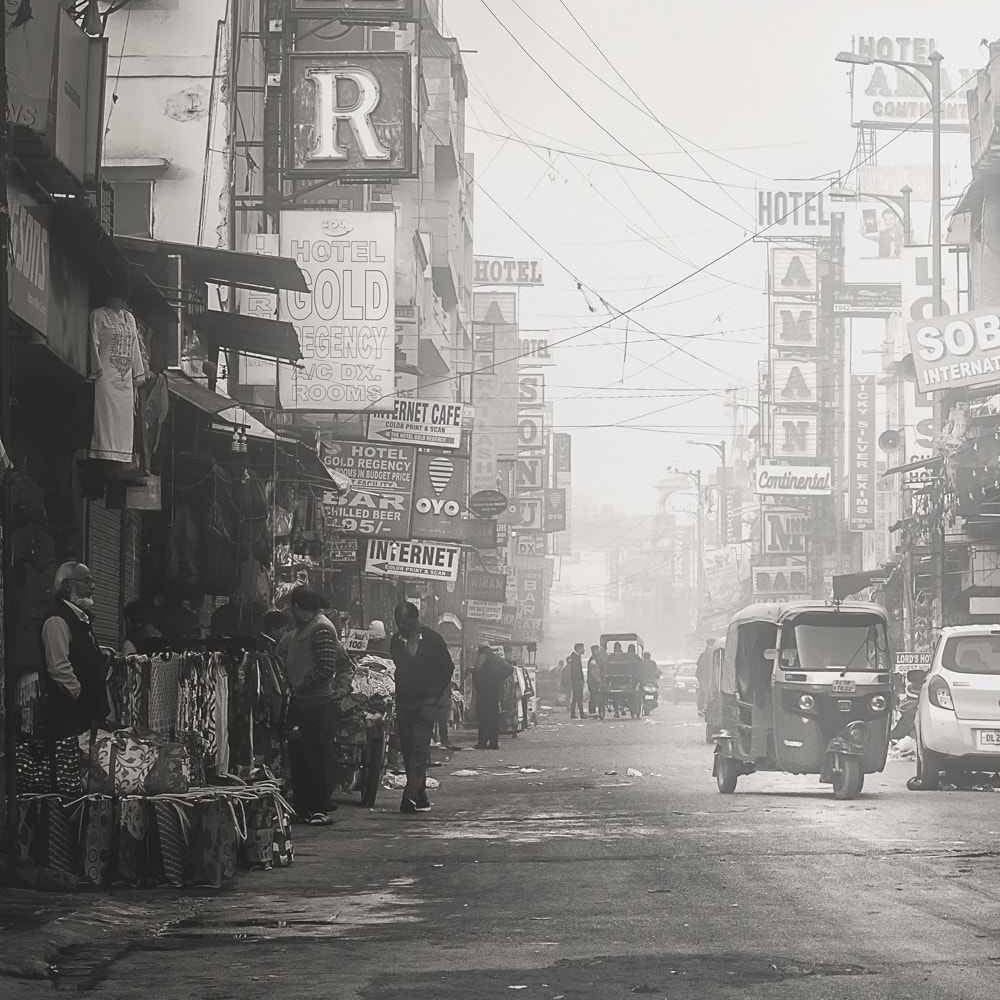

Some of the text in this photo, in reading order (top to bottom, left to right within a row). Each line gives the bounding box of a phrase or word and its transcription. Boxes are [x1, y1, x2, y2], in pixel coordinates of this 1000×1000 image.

[758, 191, 830, 226] HOTEL
[290, 240, 386, 262] HOTEL
[474, 260, 542, 283] HOTEL
[286, 268, 390, 322] GOLD
[780, 256, 812, 453] AMAN
[291, 364, 382, 381] A/C DX.
[291, 385, 383, 402] ROOMS
[857, 376, 869, 416] VICKY
[373, 400, 461, 427] ERNET CAFE
[385, 421, 404, 429] COLOR
[406, 423, 422, 431] PRINT
[351, 445, 408, 460] HOTEL
[857, 421, 869, 468] SILVER
[323, 455, 412, 472] GOLD REGENCY
[357, 469, 365, 478] IN
[365, 470, 391, 481] BUDGET
[391, 472, 410, 482] PRICE
[758, 470, 830, 489] Continental
[856, 474, 869, 514] EXIMS
[325, 506, 401, 521] CHILLED BEER
[416, 498, 460, 517] OYO
[369, 540, 458, 568] INTERNET
[520, 543, 535, 553] DX
[897, 653, 931, 664] LORD'S HO
